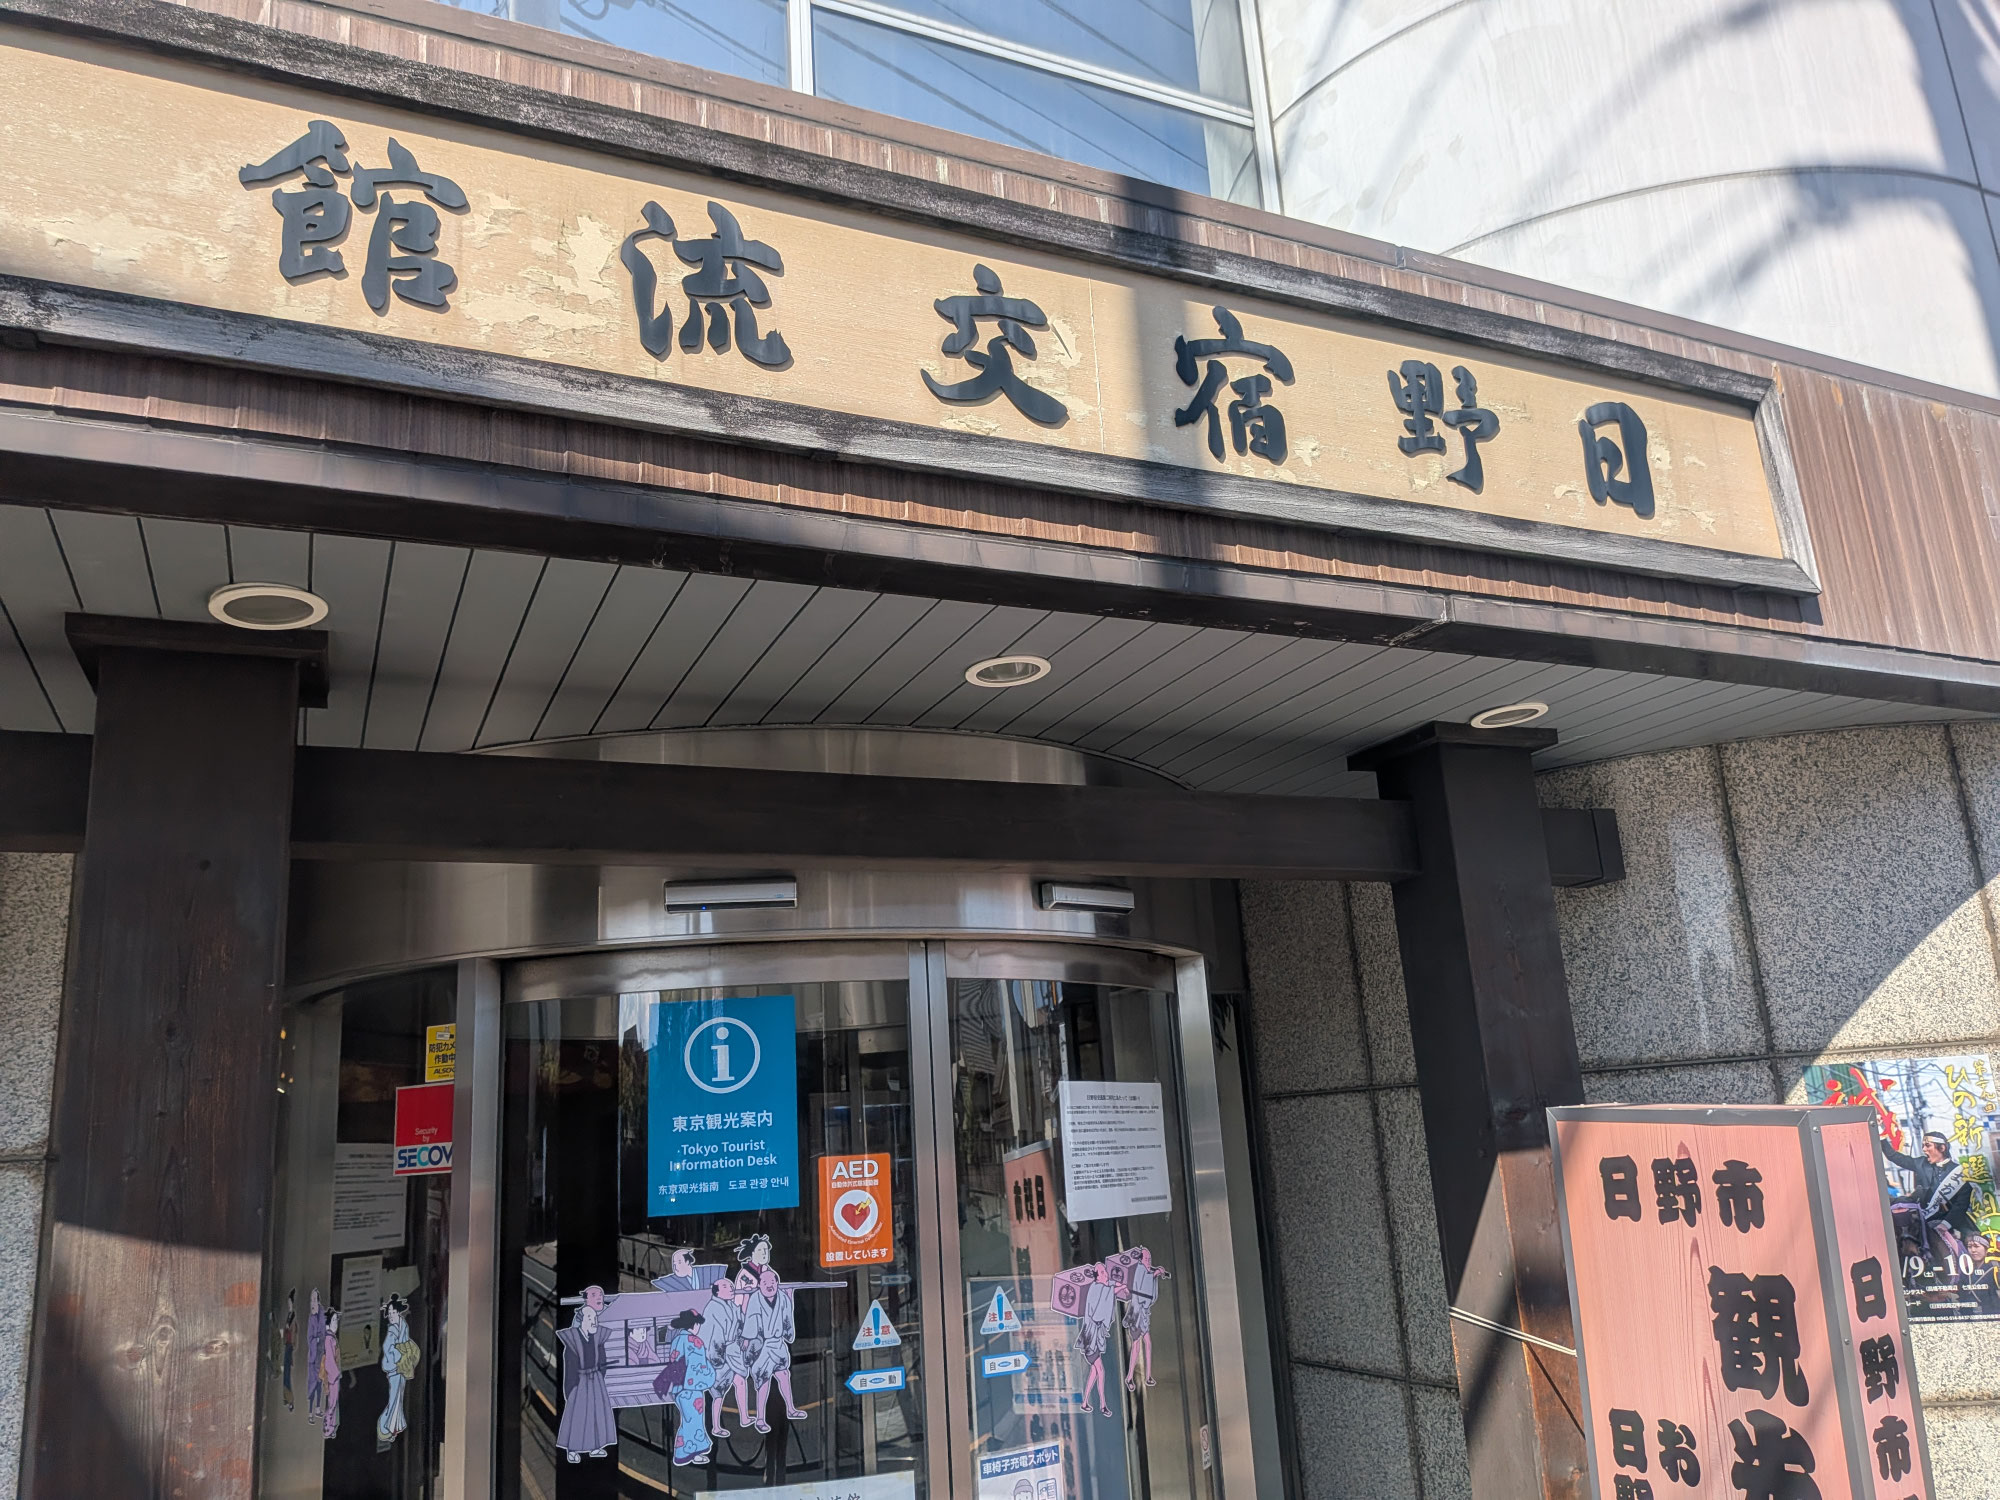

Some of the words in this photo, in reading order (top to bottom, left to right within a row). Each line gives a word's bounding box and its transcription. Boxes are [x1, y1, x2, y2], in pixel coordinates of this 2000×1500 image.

[239, 120, 1656, 519] 日野宿交流館
[415, 1126, 438, 1135] Security
[672, 1110, 773, 1133] 東京観光案内
[422, 1134, 430, 1143] by
[681, 1143, 719, 1157] Tokyo
[722, 1139, 766, 1153] Tourist
[669, 1156, 744, 1172] Information
[747, 1153, 778, 1167] Desk
[831, 1160, 879, 1180] AED
[658, 1182, 720, 1195] 东京观光指南
[728, 1179, 748, 1190] 도쿄
[750, 1177, 769, 1190] 관광
[770, 1176, 790, 1188] 안내
[1944, 1063, 2000, 1292] ひの新選組ま
[1599, 1154, 1766, 1234] 日野市
[825, 1248, 889, 1262] 設置しています
[862, 1325, 891, 1337] 注意
[1850, 1256, 1920, 1500] 日野市
[982, 1449, 1059, 1476] 車椅子充電スポット
[1657, 1418, 1701, 1488] お
